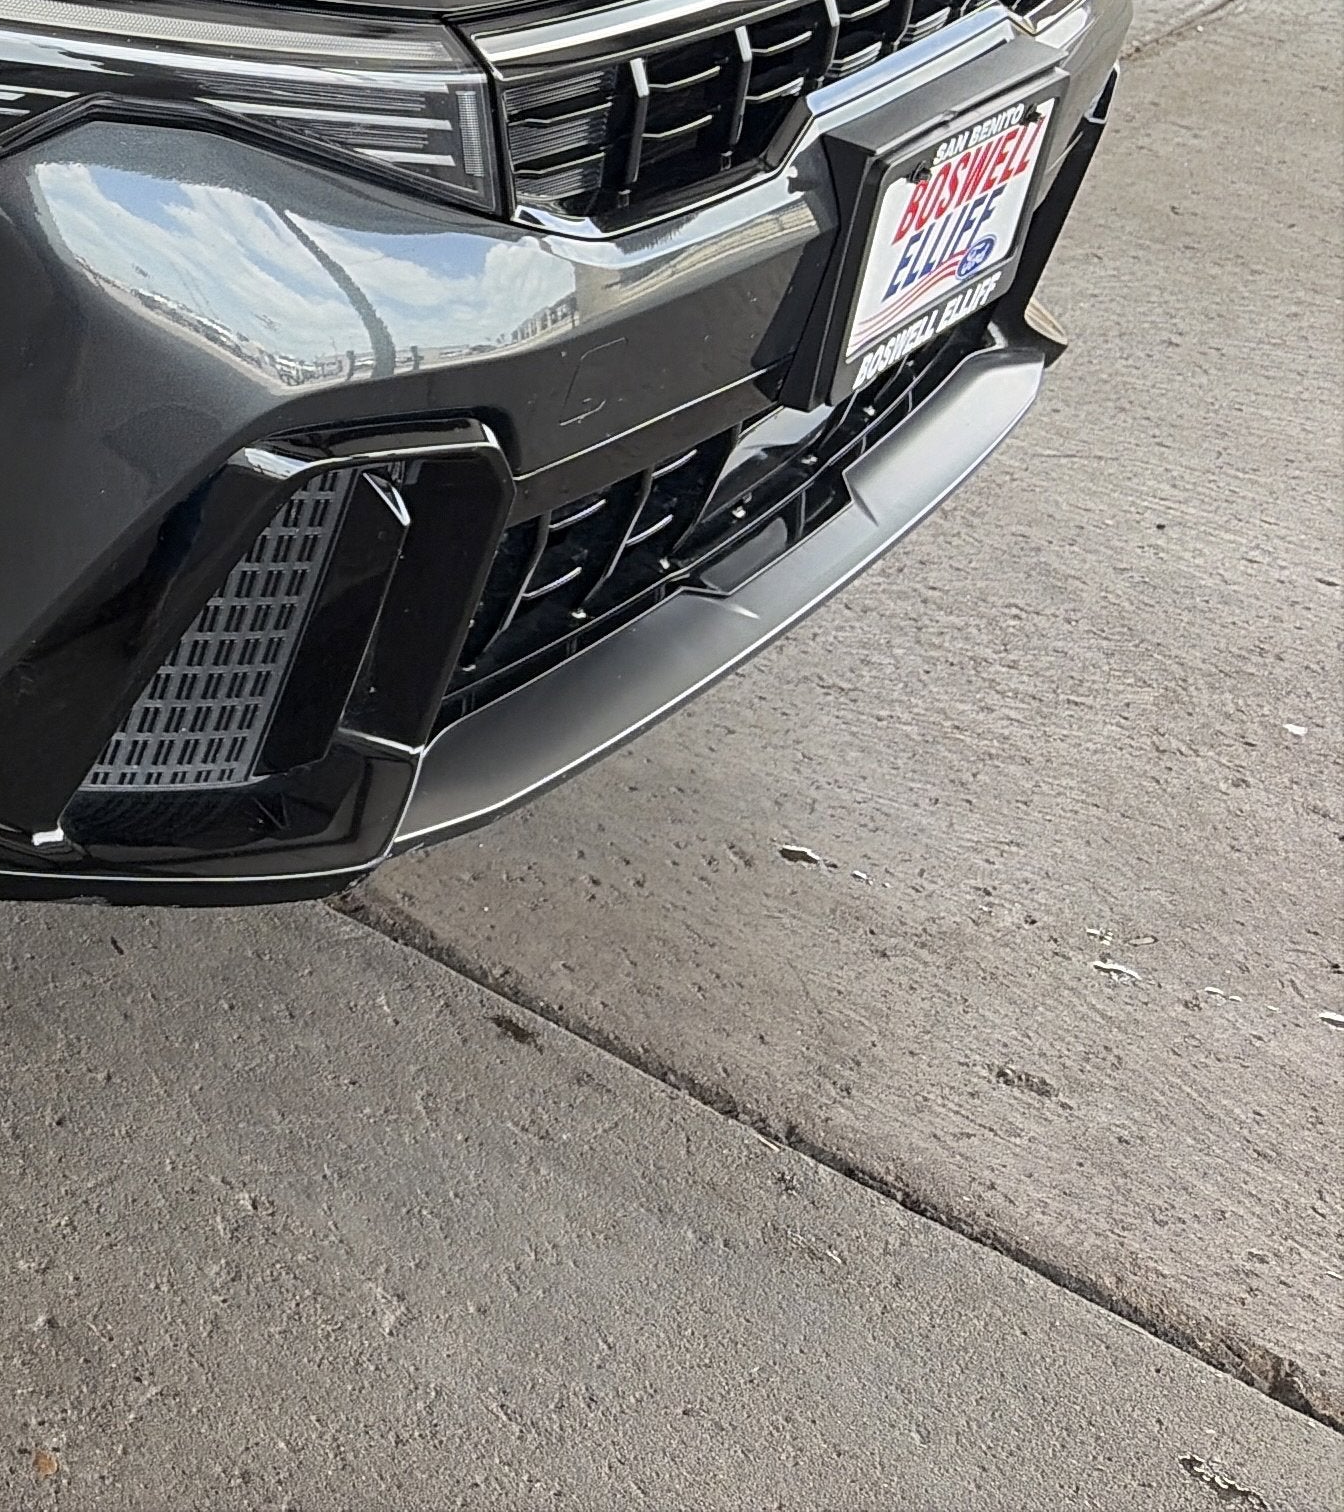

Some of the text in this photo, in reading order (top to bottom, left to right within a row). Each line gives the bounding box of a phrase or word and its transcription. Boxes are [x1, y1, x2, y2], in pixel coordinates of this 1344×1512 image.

[892, 115, 1047, 245] BOSWELL
[933, 103, 1025, 165] SAN BENITO
[881, 183, 1005, 303] ELLIFF
[852, 271, 1002, 390] BOSWELL ELLIFF
